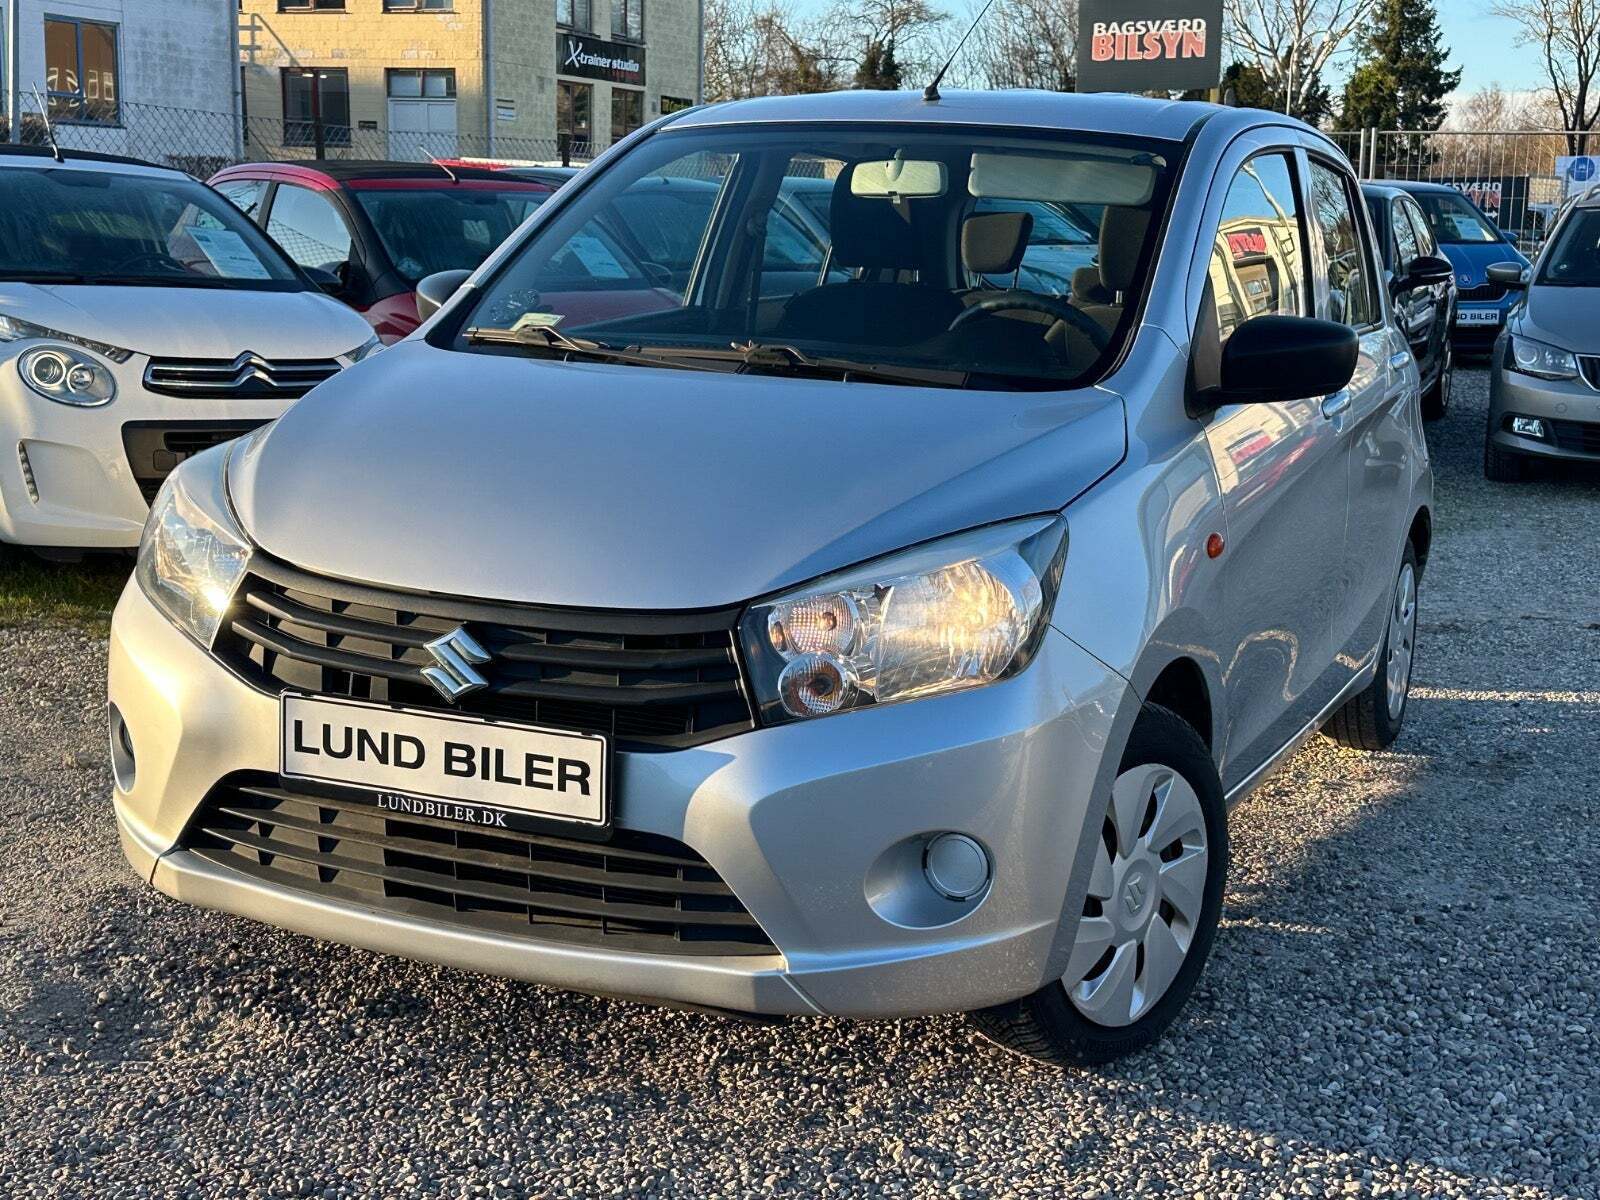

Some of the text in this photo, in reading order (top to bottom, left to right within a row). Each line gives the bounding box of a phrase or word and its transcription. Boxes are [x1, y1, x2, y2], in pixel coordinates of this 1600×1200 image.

[1093, 19, 1206, 36] BAGSVÆRD
[565, 40, 640, 72] X-trainer studio
[1092, 30, 1206, 61] BILSYN
[1470, 313, 1498, 321] BILER
[293, 719, 591, 796] LUND BILER
[377, 794, 508, 828] LUNDBILER.DK
